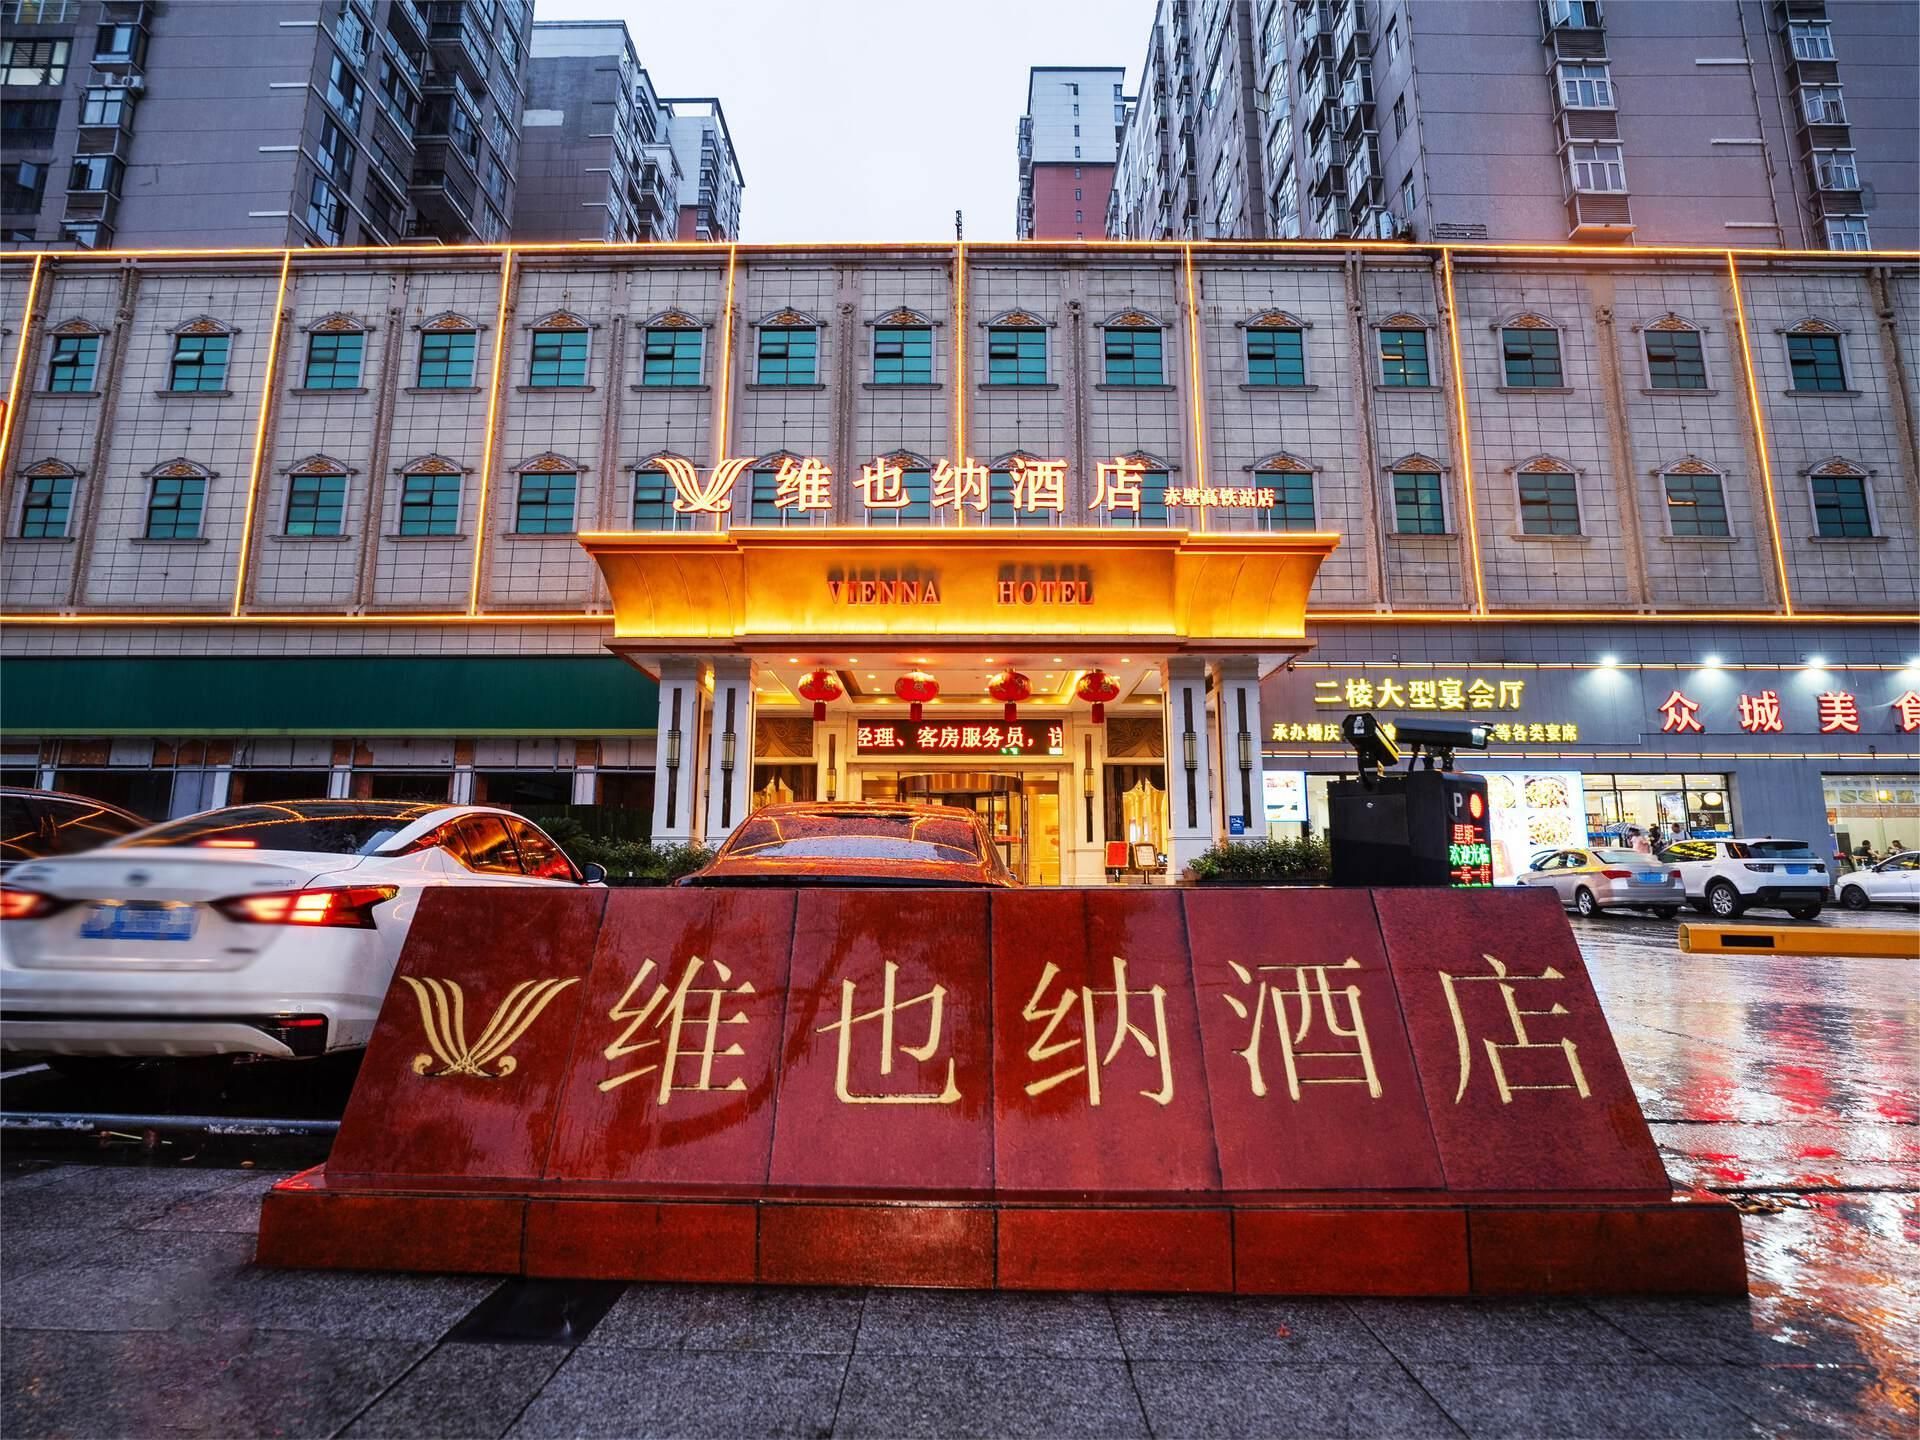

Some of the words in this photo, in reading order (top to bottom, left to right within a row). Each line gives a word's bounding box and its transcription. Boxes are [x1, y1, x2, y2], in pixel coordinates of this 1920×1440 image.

[774, 456, 1146, 514] 维也纳酒店
[1163, 486, 1276, 508] 赤壁高铁站店
[827, 580, 941, 605] VIENNA
[997, 580, 1095, 605] HOTEL
[1314, 677, 1525, 710] 二楼大型宴会厅
[1659, 690, 1920, 734] 众城美食
[1453, 792, 1463, 816] P
[1453, 824, 1485, 844] 星期二
[1449, 843, 1491, 866] 欢迎光临
[598, 953, 1593, 1108] 维也纳酒店
